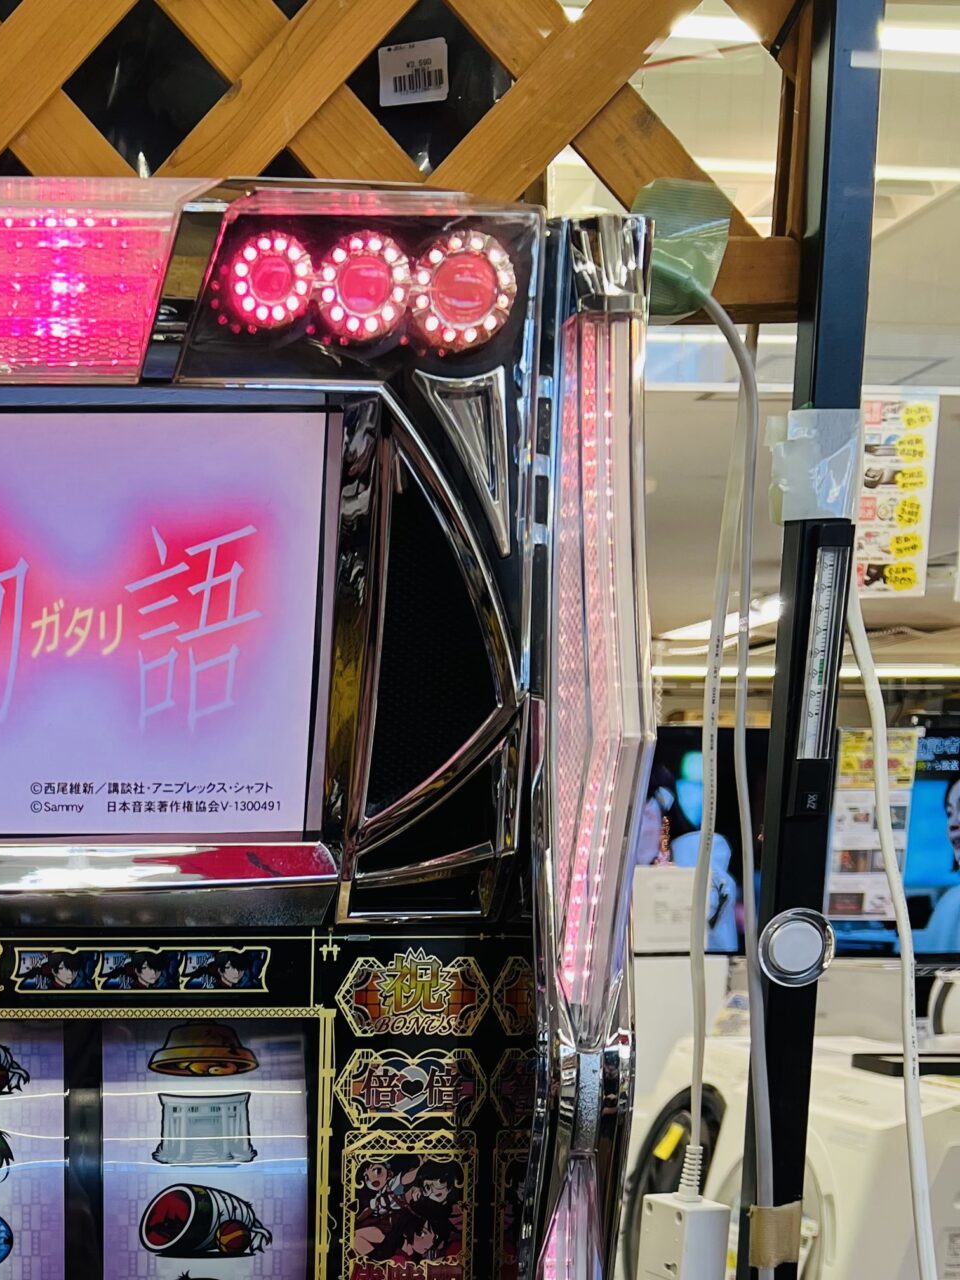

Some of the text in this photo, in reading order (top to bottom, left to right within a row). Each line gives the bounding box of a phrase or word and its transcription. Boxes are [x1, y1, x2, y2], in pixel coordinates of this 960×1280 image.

[30, 598, 124, 659] ガタリ
[125, 522, 263, 736] 語
[385, 954, 444, 1014] 祝
[373, 1014, 459, 1036] BONUS
